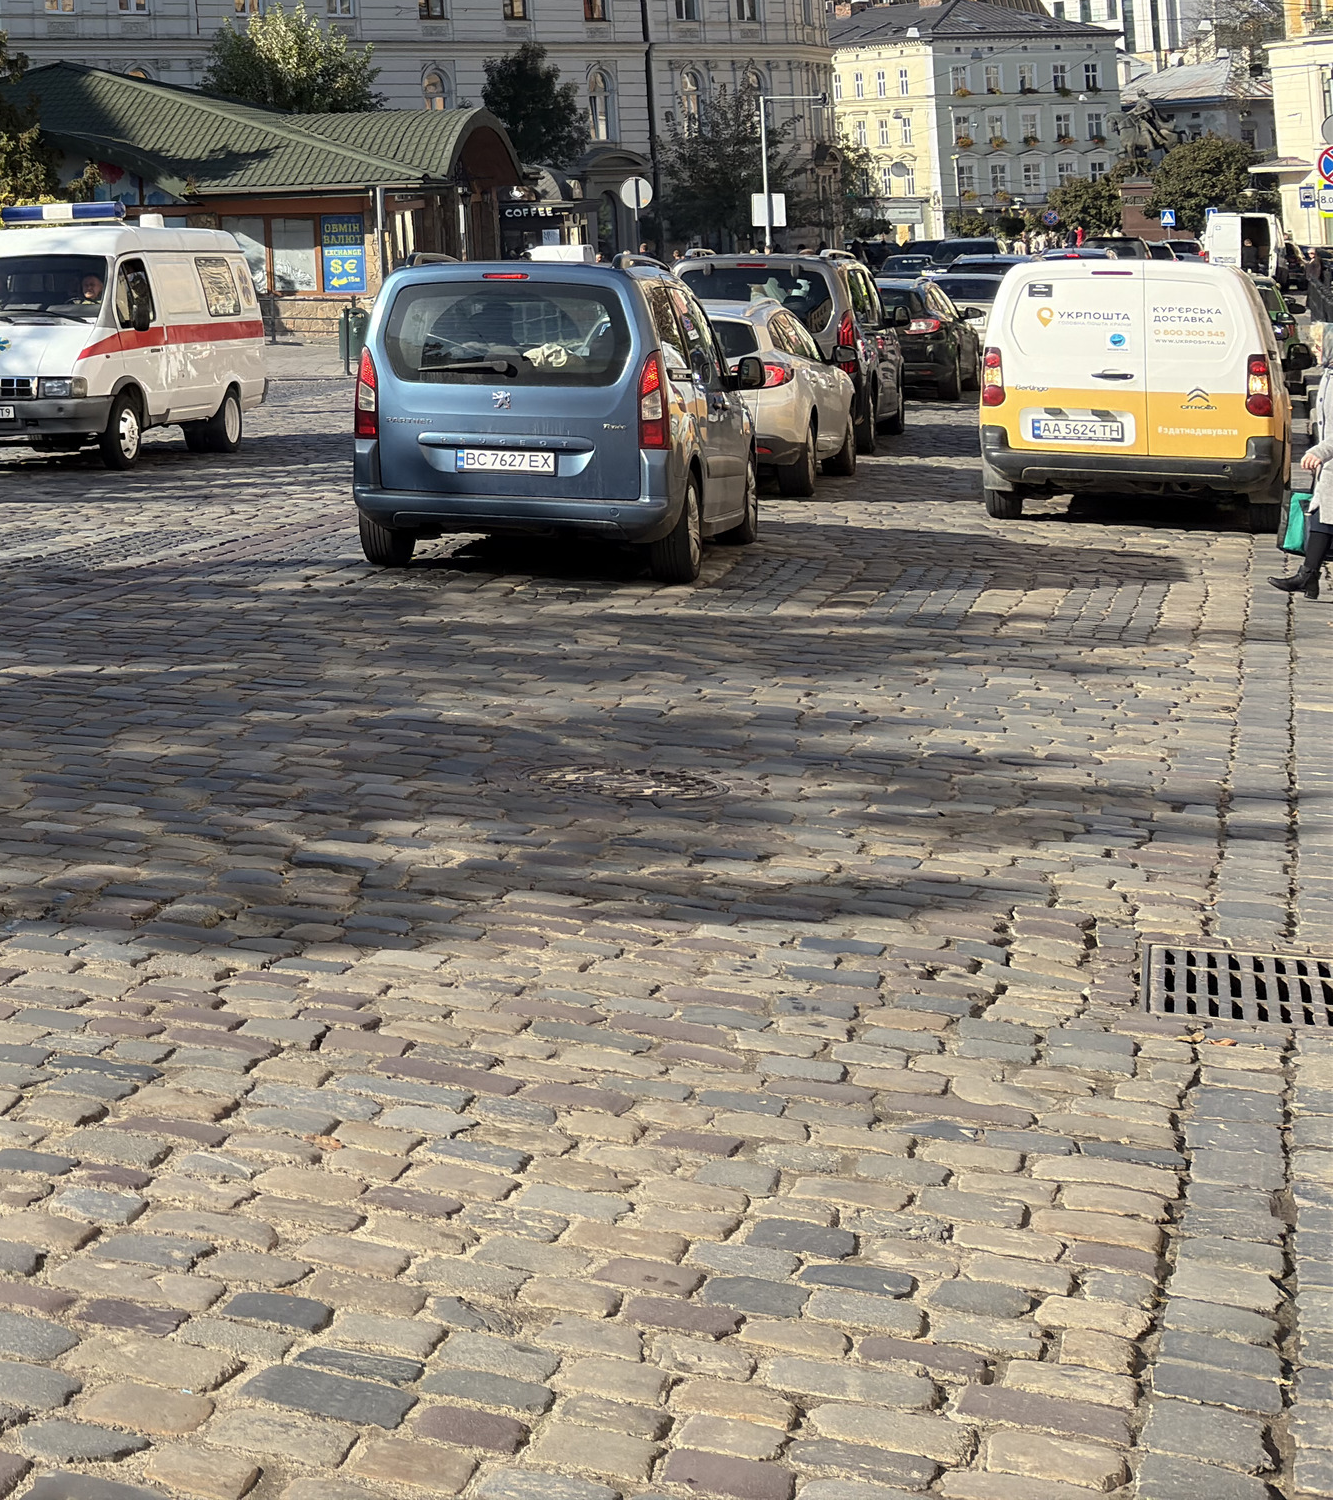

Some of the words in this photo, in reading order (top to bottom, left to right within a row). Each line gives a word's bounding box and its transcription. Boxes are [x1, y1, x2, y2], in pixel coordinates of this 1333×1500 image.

[505, 206, 553, 218] COFFEE
[324, 223, 360, 233] ОБМІН
[323, 234, 362, 244] ВАЛЮТ
[324, 248, 362, 256] EXCHANGE
[1058, 310, 1131, 321] УКРПОШТА
[1153, 315, 1214, 324] ДОСТАВКА
[1207, 330, 1226, 338] 545
[1015, 384, 1049, 393] Berlingo
[385, 416, 434, 425] PARTNER
[1042, 422, 1062, 435] AA
[1064, 423, 1097, 436] 5624
[1099, 425, 1120, 437] TH
[1157, 425, 1239, 437] #здатнадивувати
[439, 436, 569, 448] PEUGEOT
[465, 452, 488, 466] BC
[490, 453, 527, 468] 7627
[528, 454, 552, 469] EX
